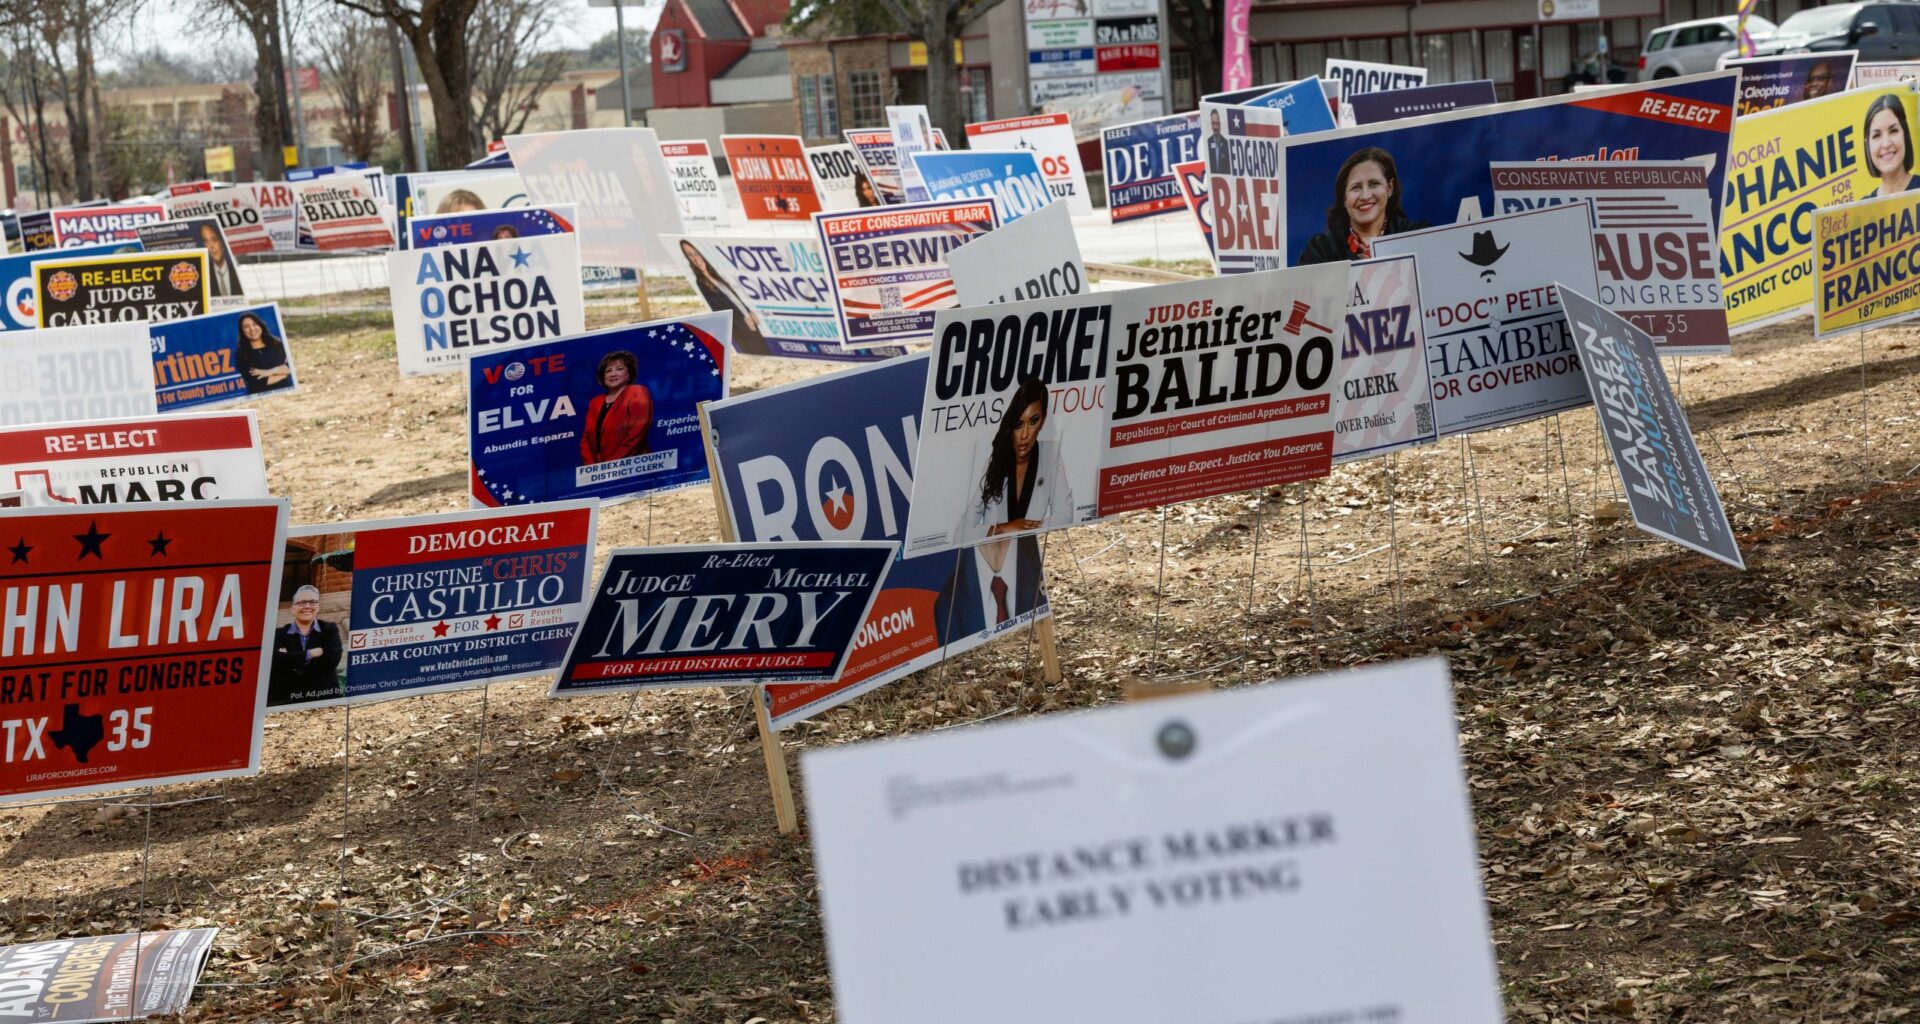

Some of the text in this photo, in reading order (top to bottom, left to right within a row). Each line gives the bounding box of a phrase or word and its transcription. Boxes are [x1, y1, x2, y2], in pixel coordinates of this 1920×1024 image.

[1744, 84, 1790, 100] Cleophus
[1395, 101, 1456, 113] REPUBLICAN
[1640, 97, 1721, 124] RE-ELECT
[676, 166, 707, 179] MARC
[735, 157, 808, 181] JOHN LIRA
[1497, 170, 1702, 186] CONSERVATIVE REPUBLICAN
[300, 187, 351, 205] Jennifer
[1831, 179, 1852, 197] FOR
[168, 199, 229, 219] Jennifer
[305, 199, 378, 222] BALIDO
[764, 197, 801, 212] TX 35
[59, 212, 160, 235] MAUREEN
[828, 206, 987, 235] ELECT CONSERVATIVE MARK
[1820, 210, 1850, 240] Elect
[416, 247, 500, 285] ANA
[715, 245, 791, 273] VOTE
[82, 267, 164, 287] RE-ELECT
[847, 275, 898, 286] YOUR CHOICE
[903, 271, 949, 281] YOUR VOICE
[87, 285, 156, 310] JUDGE
[420, 275, 557, 319] OCHOA
[1506, 285, 1559, 314] PETE
[148, 301, 198, 324] KEY
[1144, 299, 1214, 327] JUDGE
[1665, 314, 1688, 334] 35
[423, 309, 561, 351] NELSON
[1117, 305, 1282, 362] Jennifer
[153, 347, 236, 386] rtinez
[426, 353, 461, 364] FOR THE
[1112, 335, 1334, 421] BALIDO
[1343, 371, 1399, 401] CLERK
[1467, 353, 1582, 393] GOVERNOR
[177, 387, 205, 401] County
[206, 382, 228, 396] Court
[510, 384, 535, 398] FOR
[478, 395, 577, 435] ELVA
[931, 398, 1005, 434] TEXAS
[1115, 398, 1326, 442] Republican for Court of Criminal Appeals, Place 9
[1335, 411, 1396, 435] OVER Politics!
[1576, 323, 1654, 497] LAUREN
[1600, 337, 1673, 506] ZAMORA
[44, 429, 158, 454] RE-ELECT
[1617, 342, 1691, 514] FOR JUDGE
[484, 430, 575, 454] Abundis Esparza
[1634, 355, 1708, 540] BEXAR COUNTY COURT
[100, 463, 189, 478] REPUBLICAN
[580, 450, 674, 475] FOR BEXAR COUNTY
[590, 462, 665, 482] DISTRICT CLERK
[1110, 440, 1325, 487] Experience You Expect. Justice You Deserve.
[78, 477, 219, 505] MARC
[738, 414, 918, 543] RON
[407, 521, 554, 555] DEMOCRAT
[702, 553, 775, 570] Re-Elect
[371, 566, 483, 594] CHRISTINE
[370, 574, 564, 625] CASTILLO
[530, 606, 563, 618] Proven
[1, 573, 245, 657] HN LIRA
[453, 619, 480, 634] FOR
[529, 614, 564, 627] Results
[591, 591, 852, 658] MERY
[371, 632, 426, 648] Experience
[388, 625, 414, 636] Years
[351, 626, 575, 667] BEXAR COUNTY DISTRICT CLERK
[419, 653, 509, 673] www.VoteChrisCastillo.com
[601, 663, 634, 676] FOR
[638, 659, 679, 674] 144TH
[683, 656, 755, 670] DISTRICT
[757, 654, 807, 668] JUDGE
[61, 668, 108, 699] FOR
[118, 657, 244, 694] CONGRESS
[290, 691, 304, 700] Pol.
[334, 686, 345, 698] by
[345, 681, 377, 693] Christine
[400, 674, 426, 686] Castillo
[462, 667, 492, 679] Amanda
[492, 664, 511, 675] Muth
[511, 660, 542, 671] treasurer
[2, 706, 153, 763] TX 35
[26, 765, 117, 783] LIRAFORCONGRESS.COM
[956, 812, 1340, 895] DISTANCE MARKER
[1002, 861, 1302, 934] EARLY VOTING
[43, 941, 116, 1004] CONGRESS
